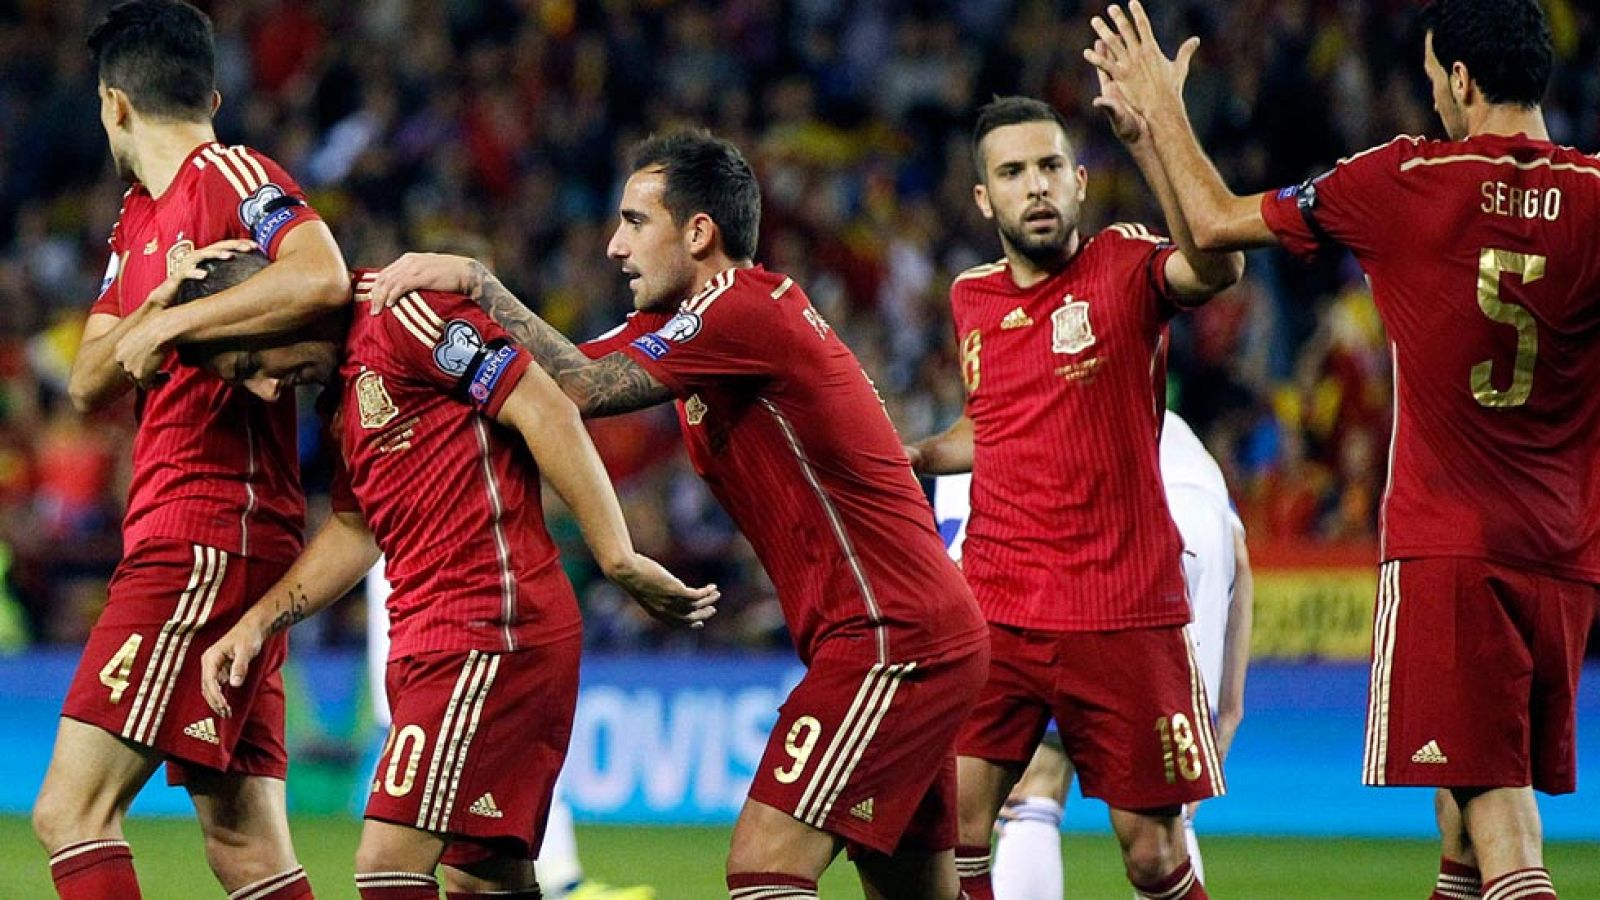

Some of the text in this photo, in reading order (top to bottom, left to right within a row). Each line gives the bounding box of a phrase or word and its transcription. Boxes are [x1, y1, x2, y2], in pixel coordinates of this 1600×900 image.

[1480, 181, 1562, 221] SERGIO
[1470, 248, 1546, 408] 5
[480, 345, 512, 386] RESPECT
[99, 633, 143, 704] 4
[774, 715, 821, 784] 9
[1154, 712, 1202, 784] 18
